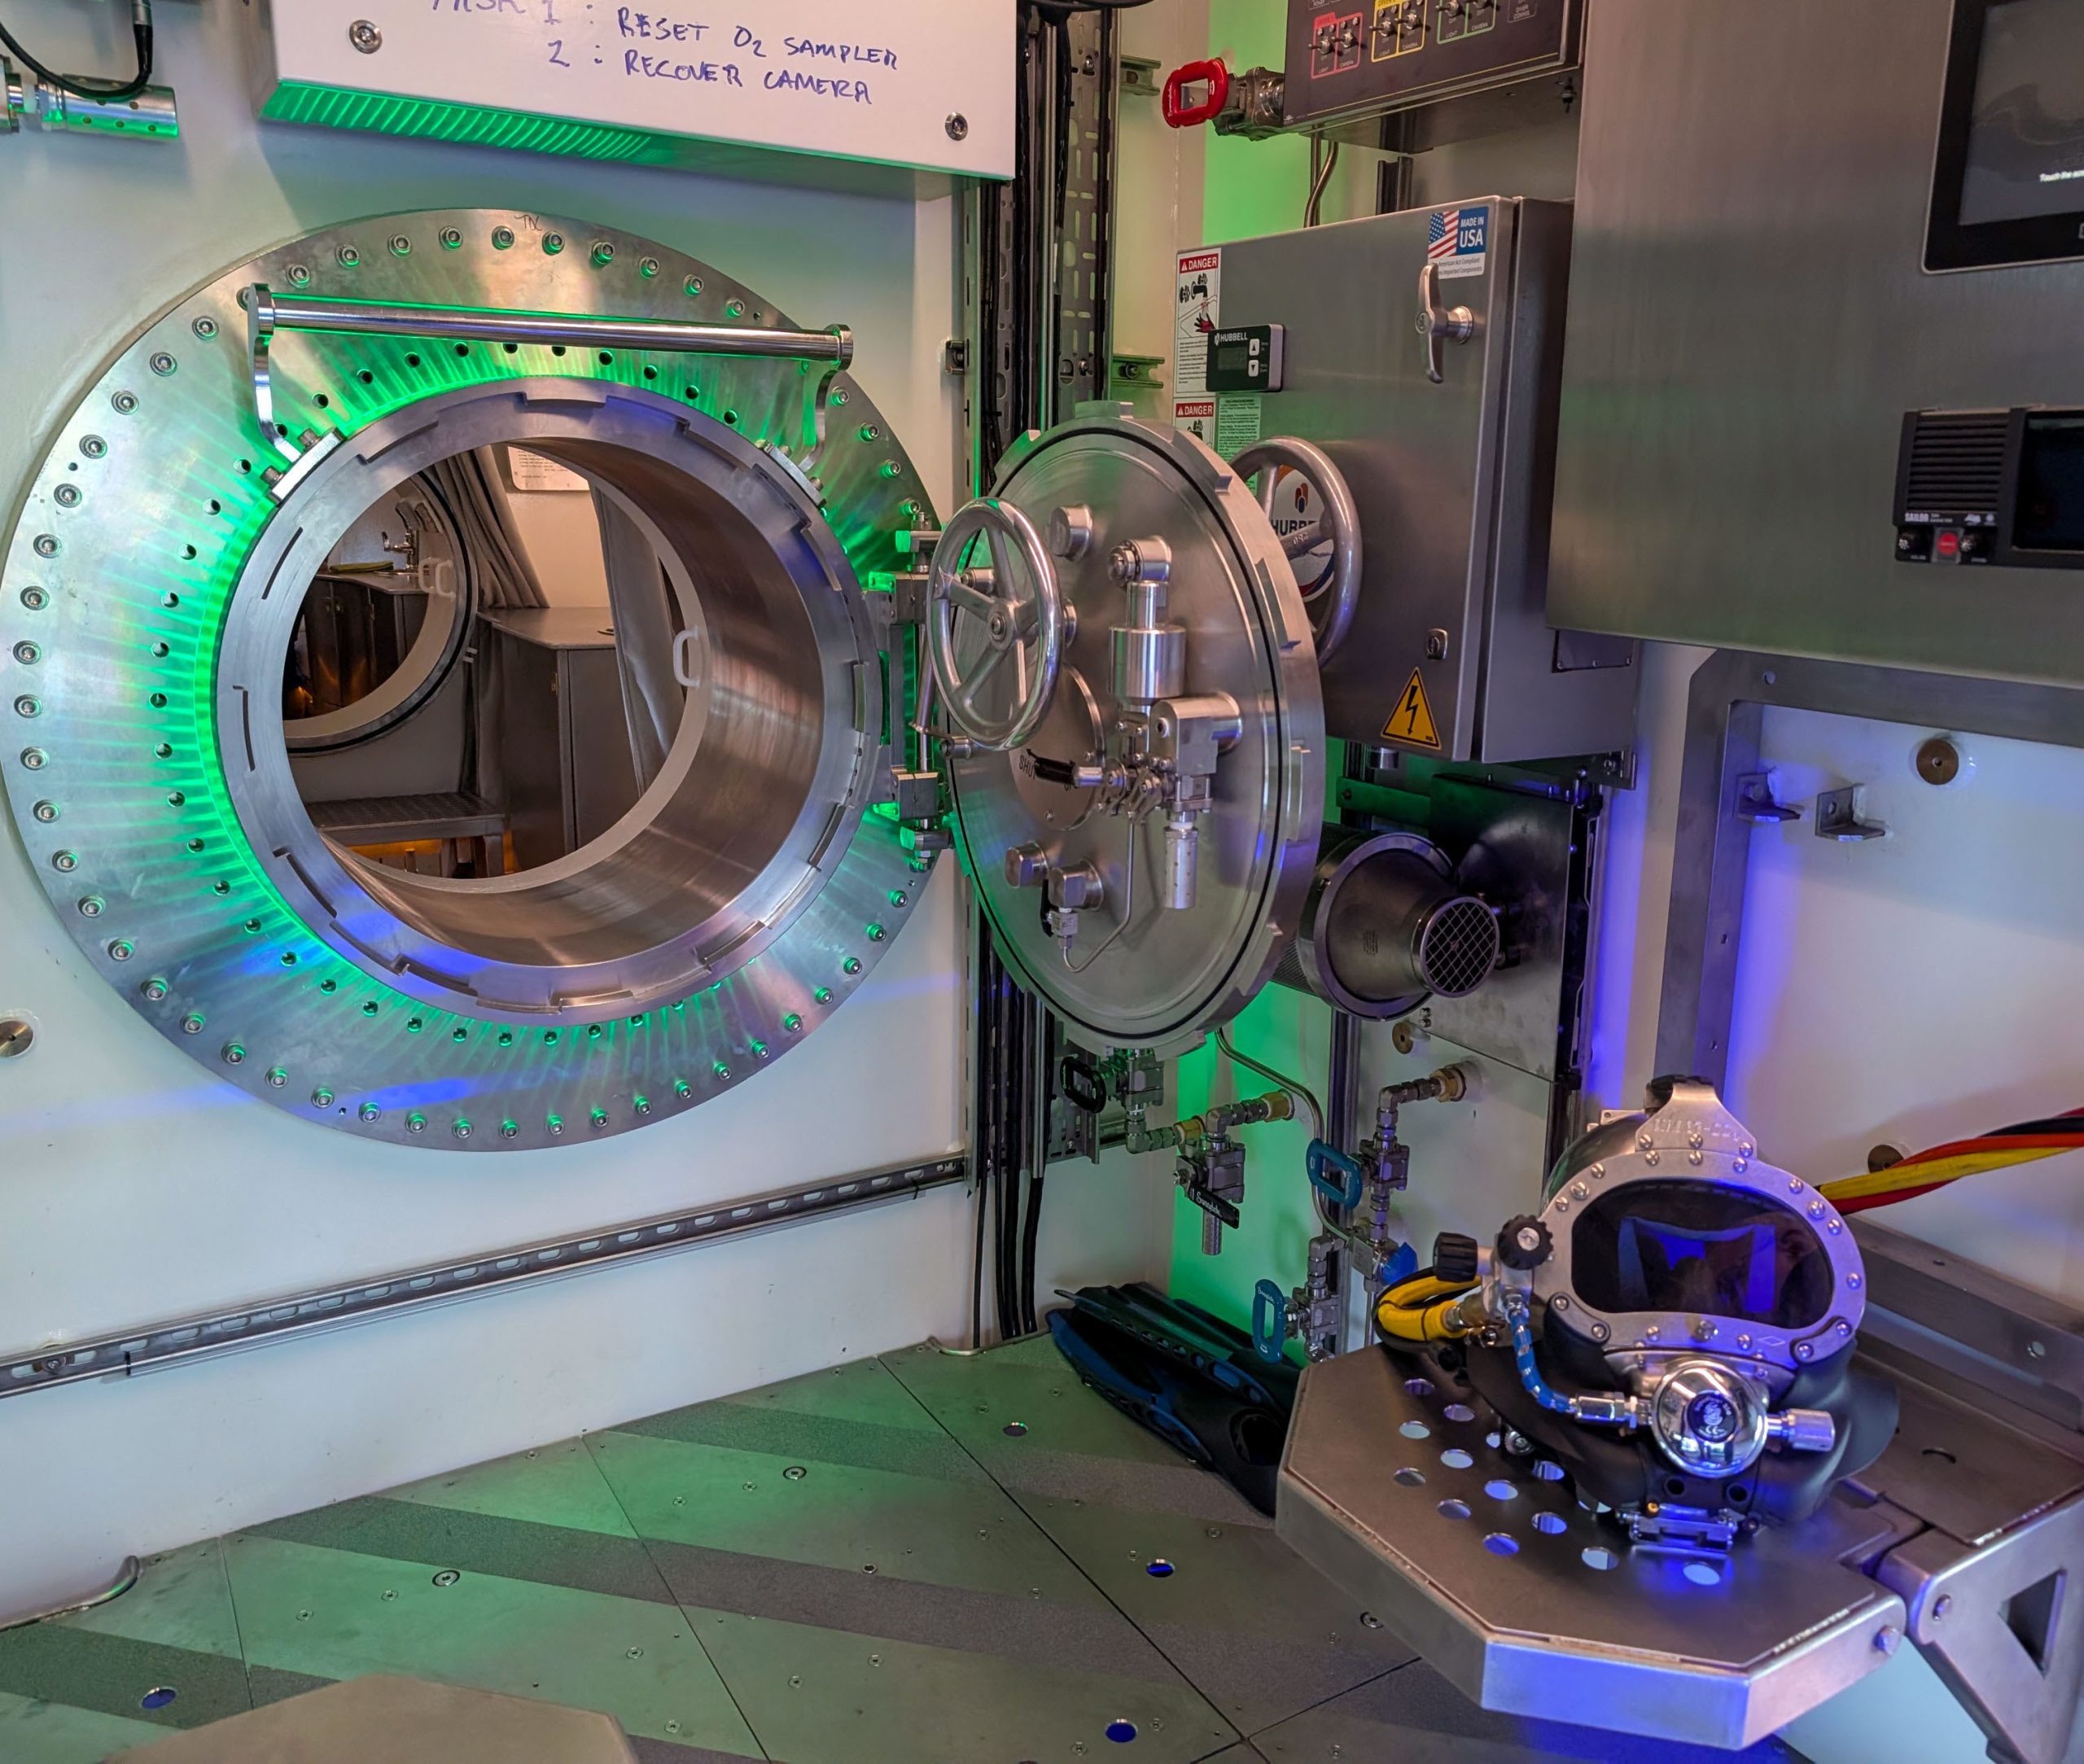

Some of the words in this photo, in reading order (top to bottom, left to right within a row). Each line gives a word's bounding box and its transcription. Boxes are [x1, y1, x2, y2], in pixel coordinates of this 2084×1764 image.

[618, 7, 709, 40] RESET
[783, 37, 898, 70] SAMPLER
[548, 40, 570, 67] 2
[624, 49, 742, 87] RECOVER
[764, 69, 872, 104] CAMERA
[1460, 217, 1477, 228] MADE
[1478, 216, 1484, 225] IN
[1460, 229, 1483, 248] USA
[1188, 256, 1217, 270] DANGER
[1220, 332, 1248, 343] HUBBELL
[1184, 405, 1212, 416] DANGER
